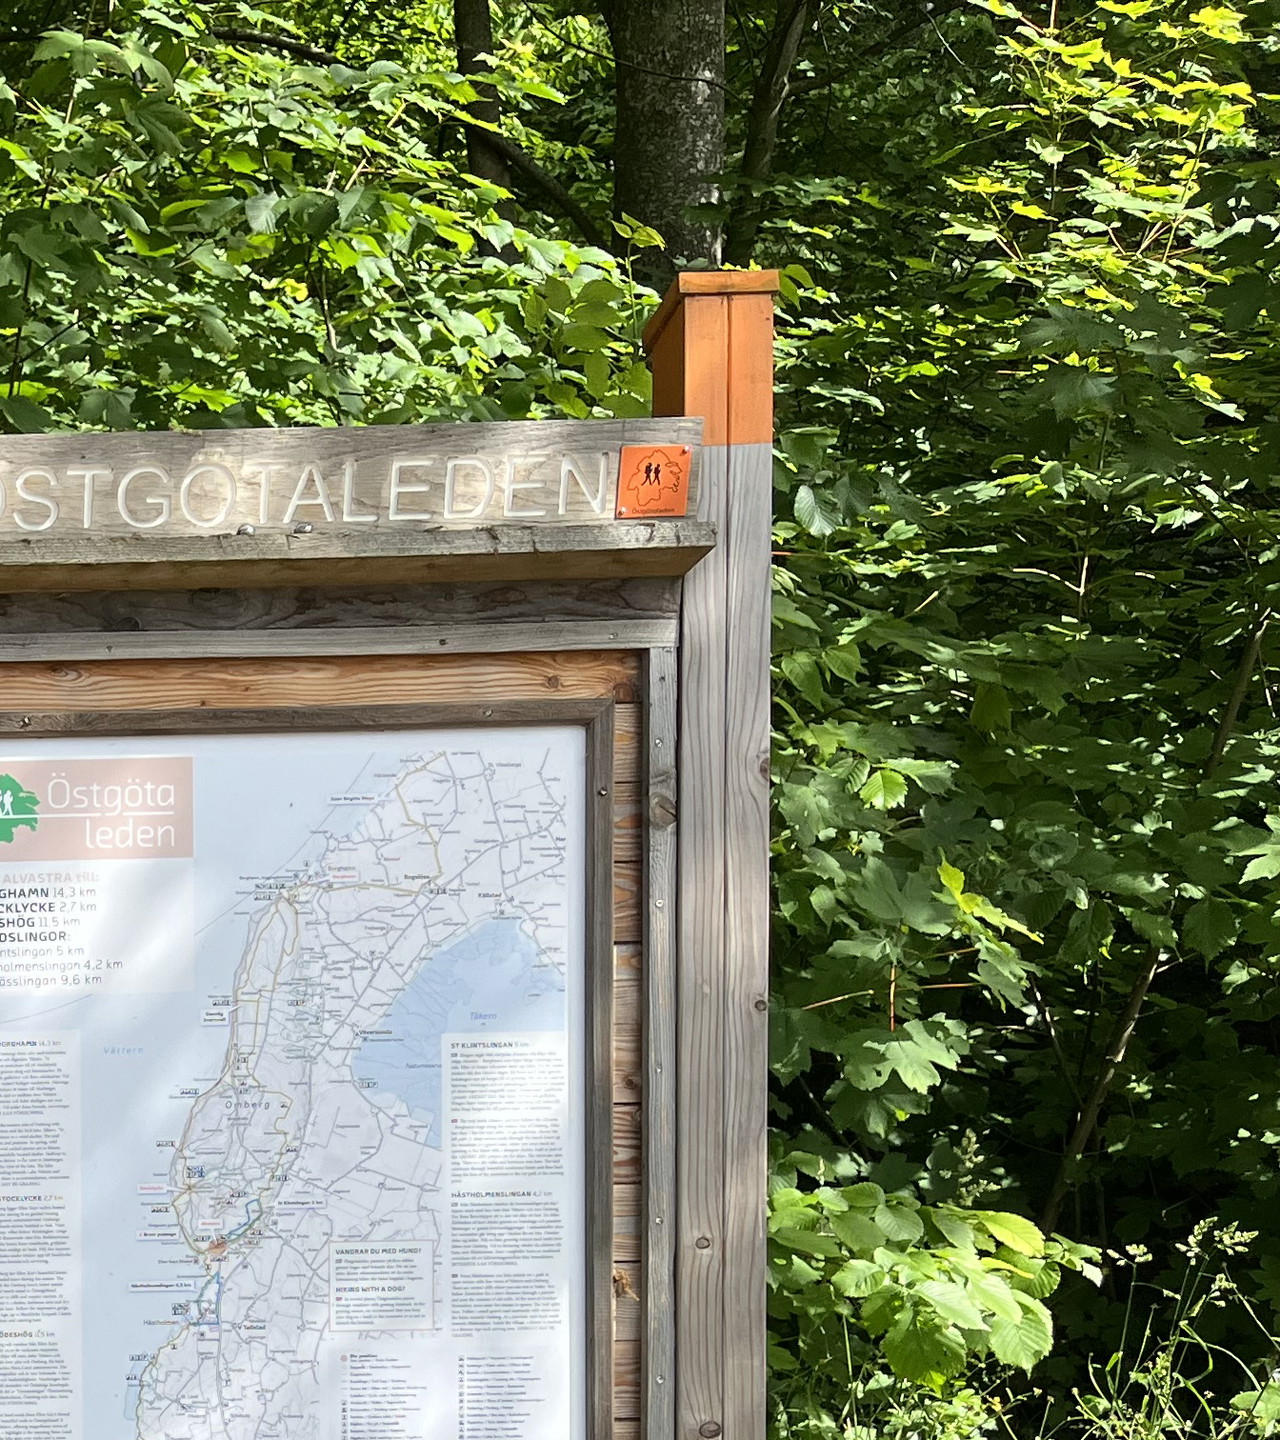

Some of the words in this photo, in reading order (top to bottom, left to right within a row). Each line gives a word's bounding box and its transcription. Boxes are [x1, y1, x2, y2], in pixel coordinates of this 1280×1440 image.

[47, 772, 175, 816] Östgöta
[86, 818, 175, 849] leden
[3, 872, 72, 885] ALVASTRA
[52, 887, 76, 899] 14,3
[79, 887, 96, 897] km
[59, 901, 77, 913] 2,7
[80, 902, 97, 912] km
[38, 916, 59, 928] 11,5
[63, 917, 81, 926] km
[56, 946, 64, 956] 5
[68, 946, 85, 956] km
[84, 959, 103, 971] 4,2
[106, 958, 124, 970] km
[60, 974, 81, 986] 9,6
[85, 974, 102, 985] km
